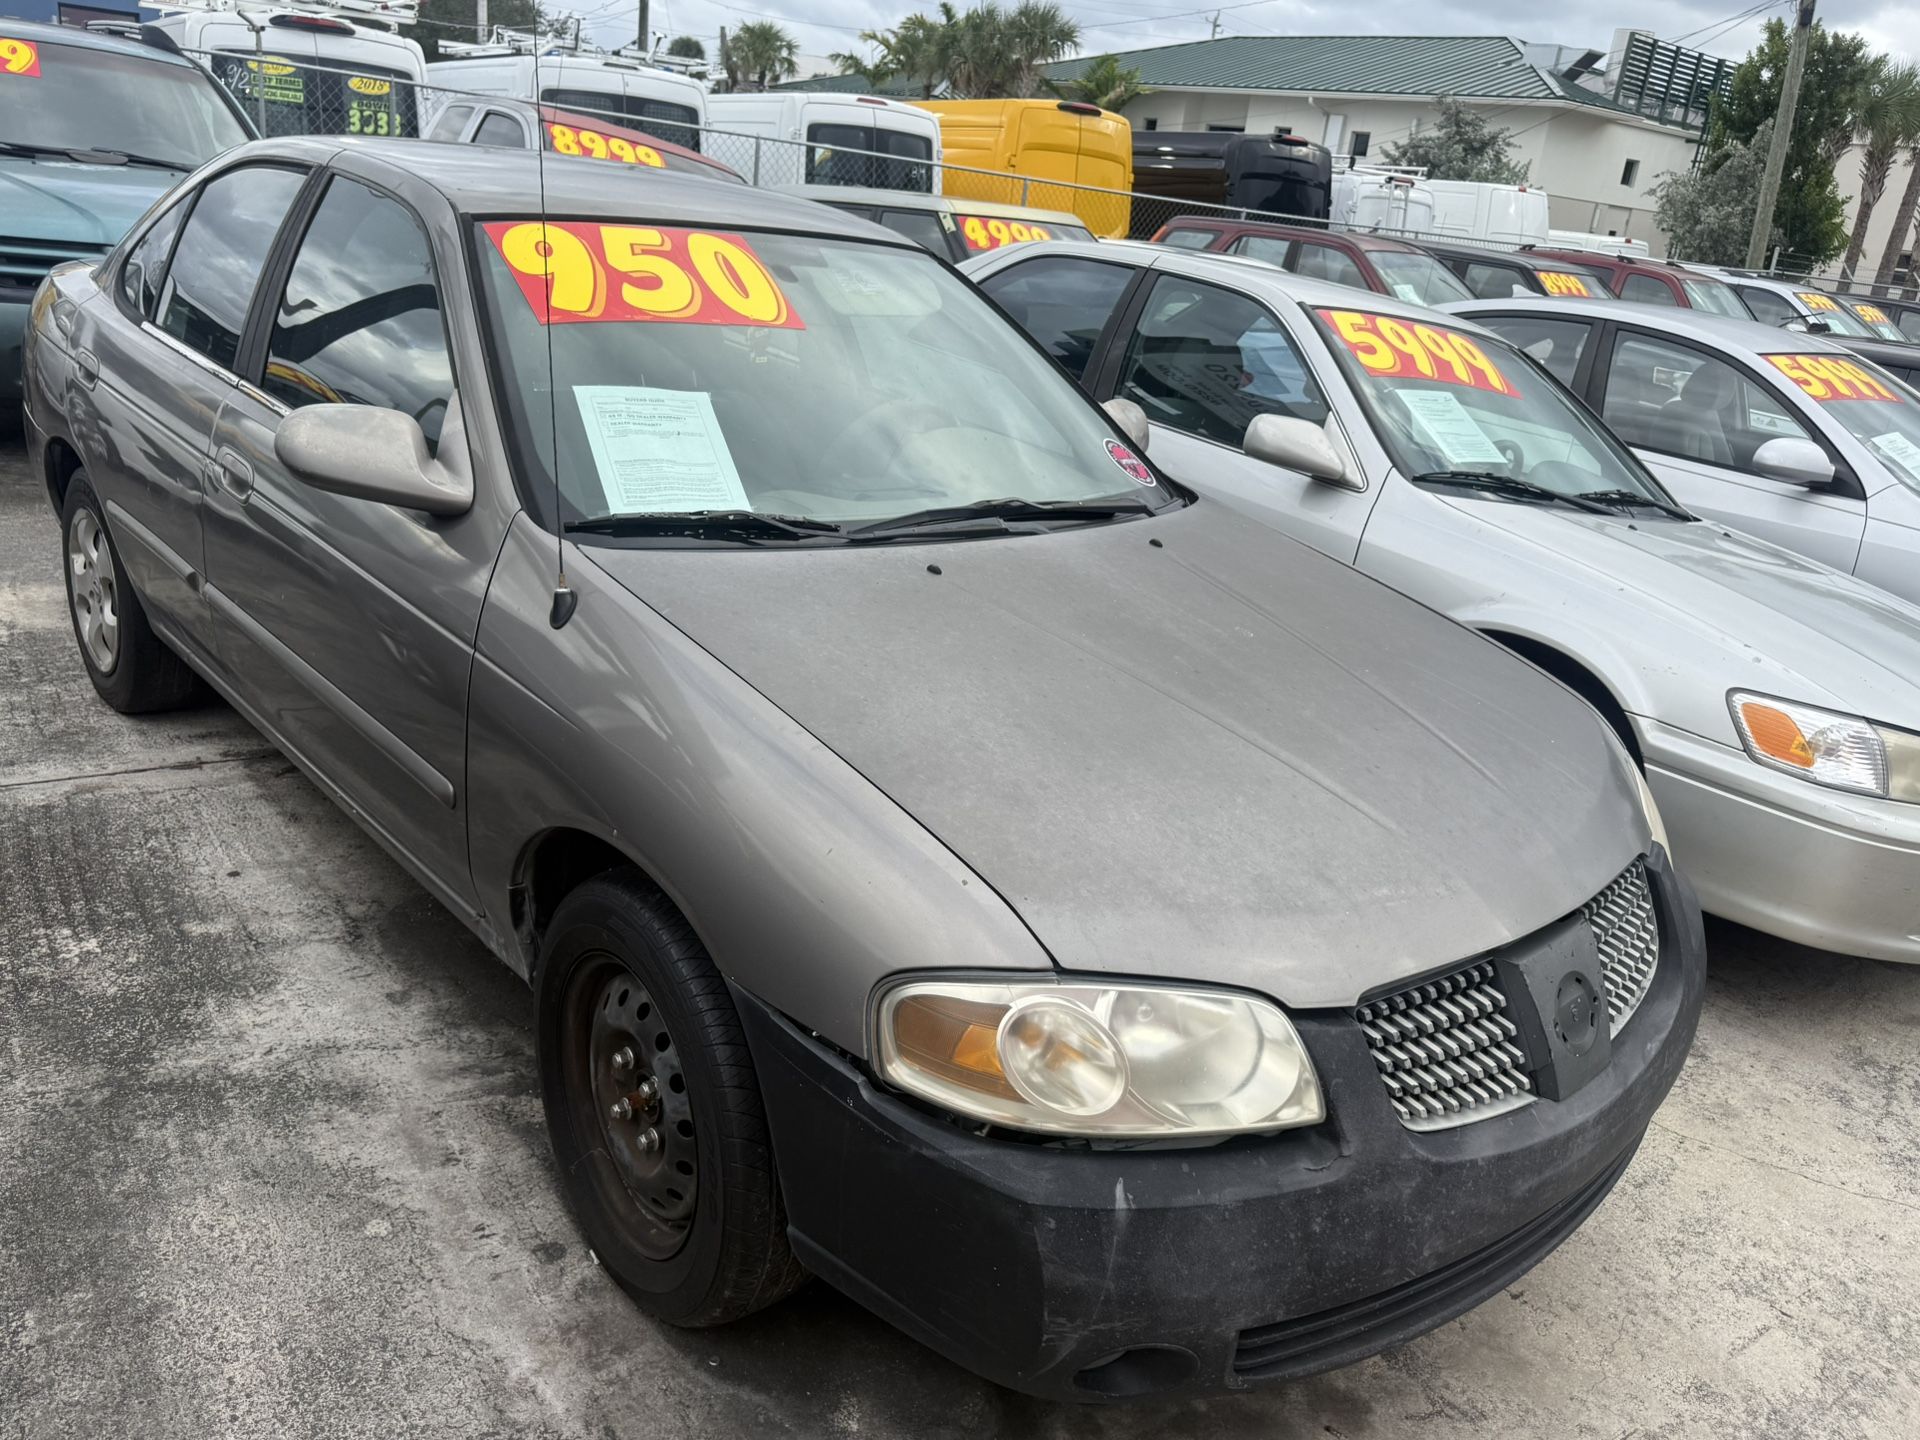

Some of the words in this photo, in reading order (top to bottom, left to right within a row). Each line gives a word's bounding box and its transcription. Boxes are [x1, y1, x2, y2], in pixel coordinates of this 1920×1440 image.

[252, 75, 274, 85] ESY
[550, 124, 667, 168] 8999
[502, 223, 787, 324] 950
[1330, 311, 1508, 394] 5999
[1768, 355, 1897, 400] 5999
